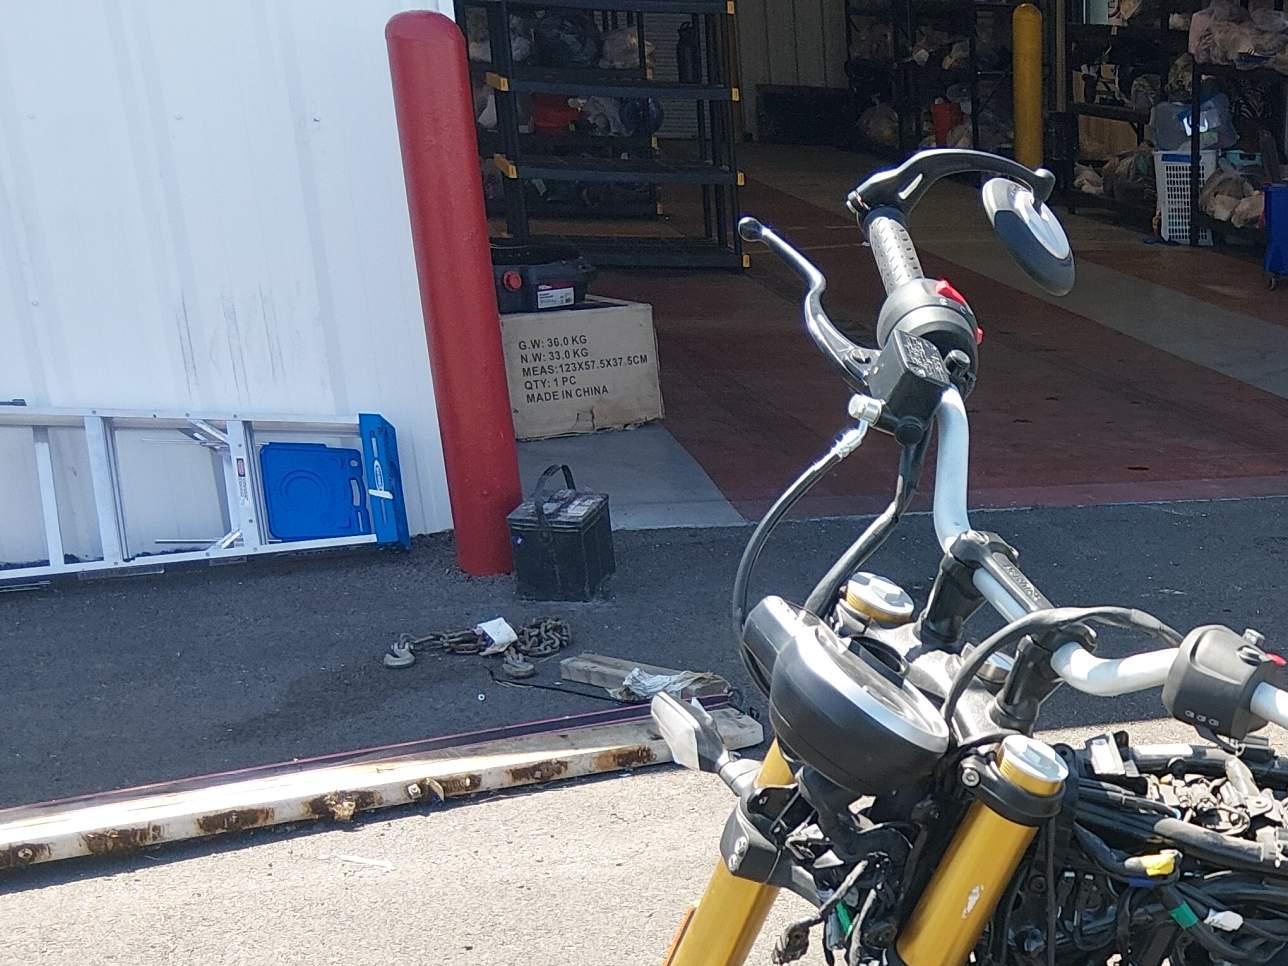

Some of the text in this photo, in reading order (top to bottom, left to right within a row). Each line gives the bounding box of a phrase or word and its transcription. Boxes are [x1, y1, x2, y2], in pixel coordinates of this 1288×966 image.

[518, 335, 588, 350] G.W: 36.0 KG
[520, 348, 589, 364] N.W: 33.0 KG
[524, 376, 577, 390] QTY: 1 PC
[526, 385, 609, 404] MADE IN CHINA
